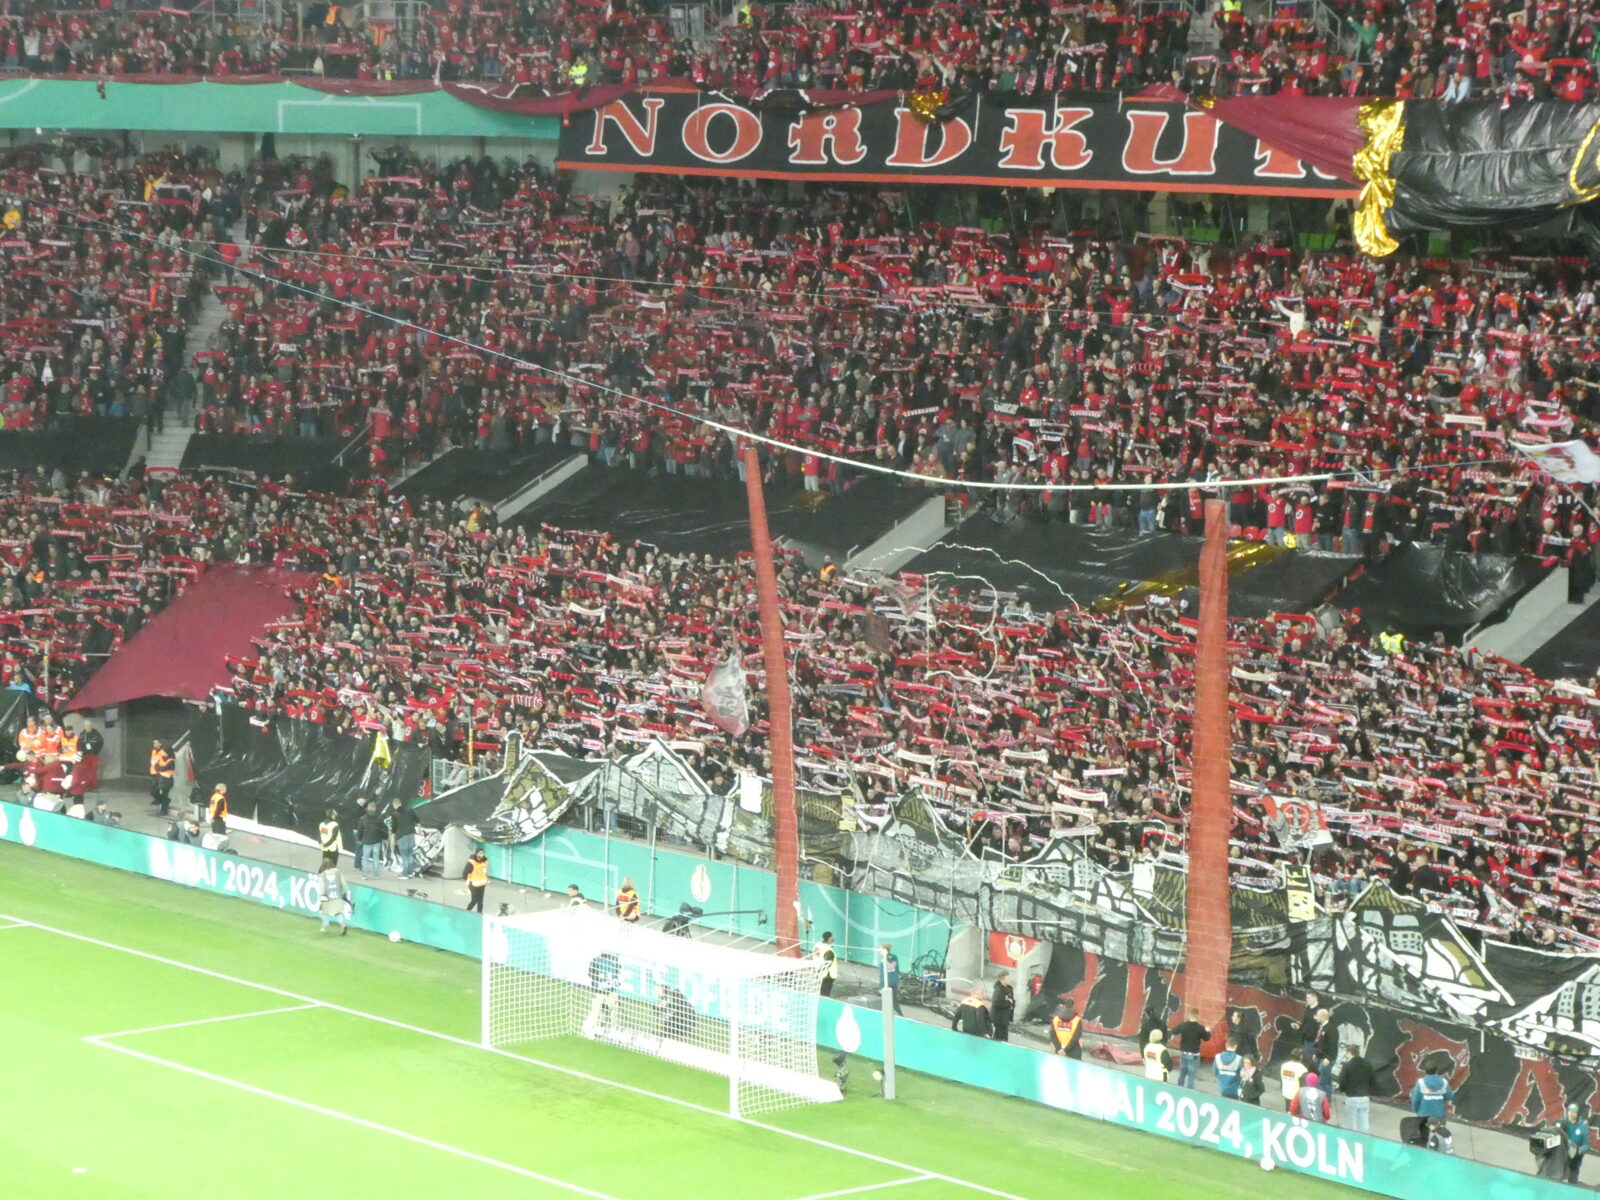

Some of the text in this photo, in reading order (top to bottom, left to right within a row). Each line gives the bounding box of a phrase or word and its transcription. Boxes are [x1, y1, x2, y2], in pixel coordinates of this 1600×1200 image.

[223, 860, 285, 909] 2024,
[1155, 1091, 1253, 1158] 2024,
[1263, 1116, 1365, 1182] KÖLN
